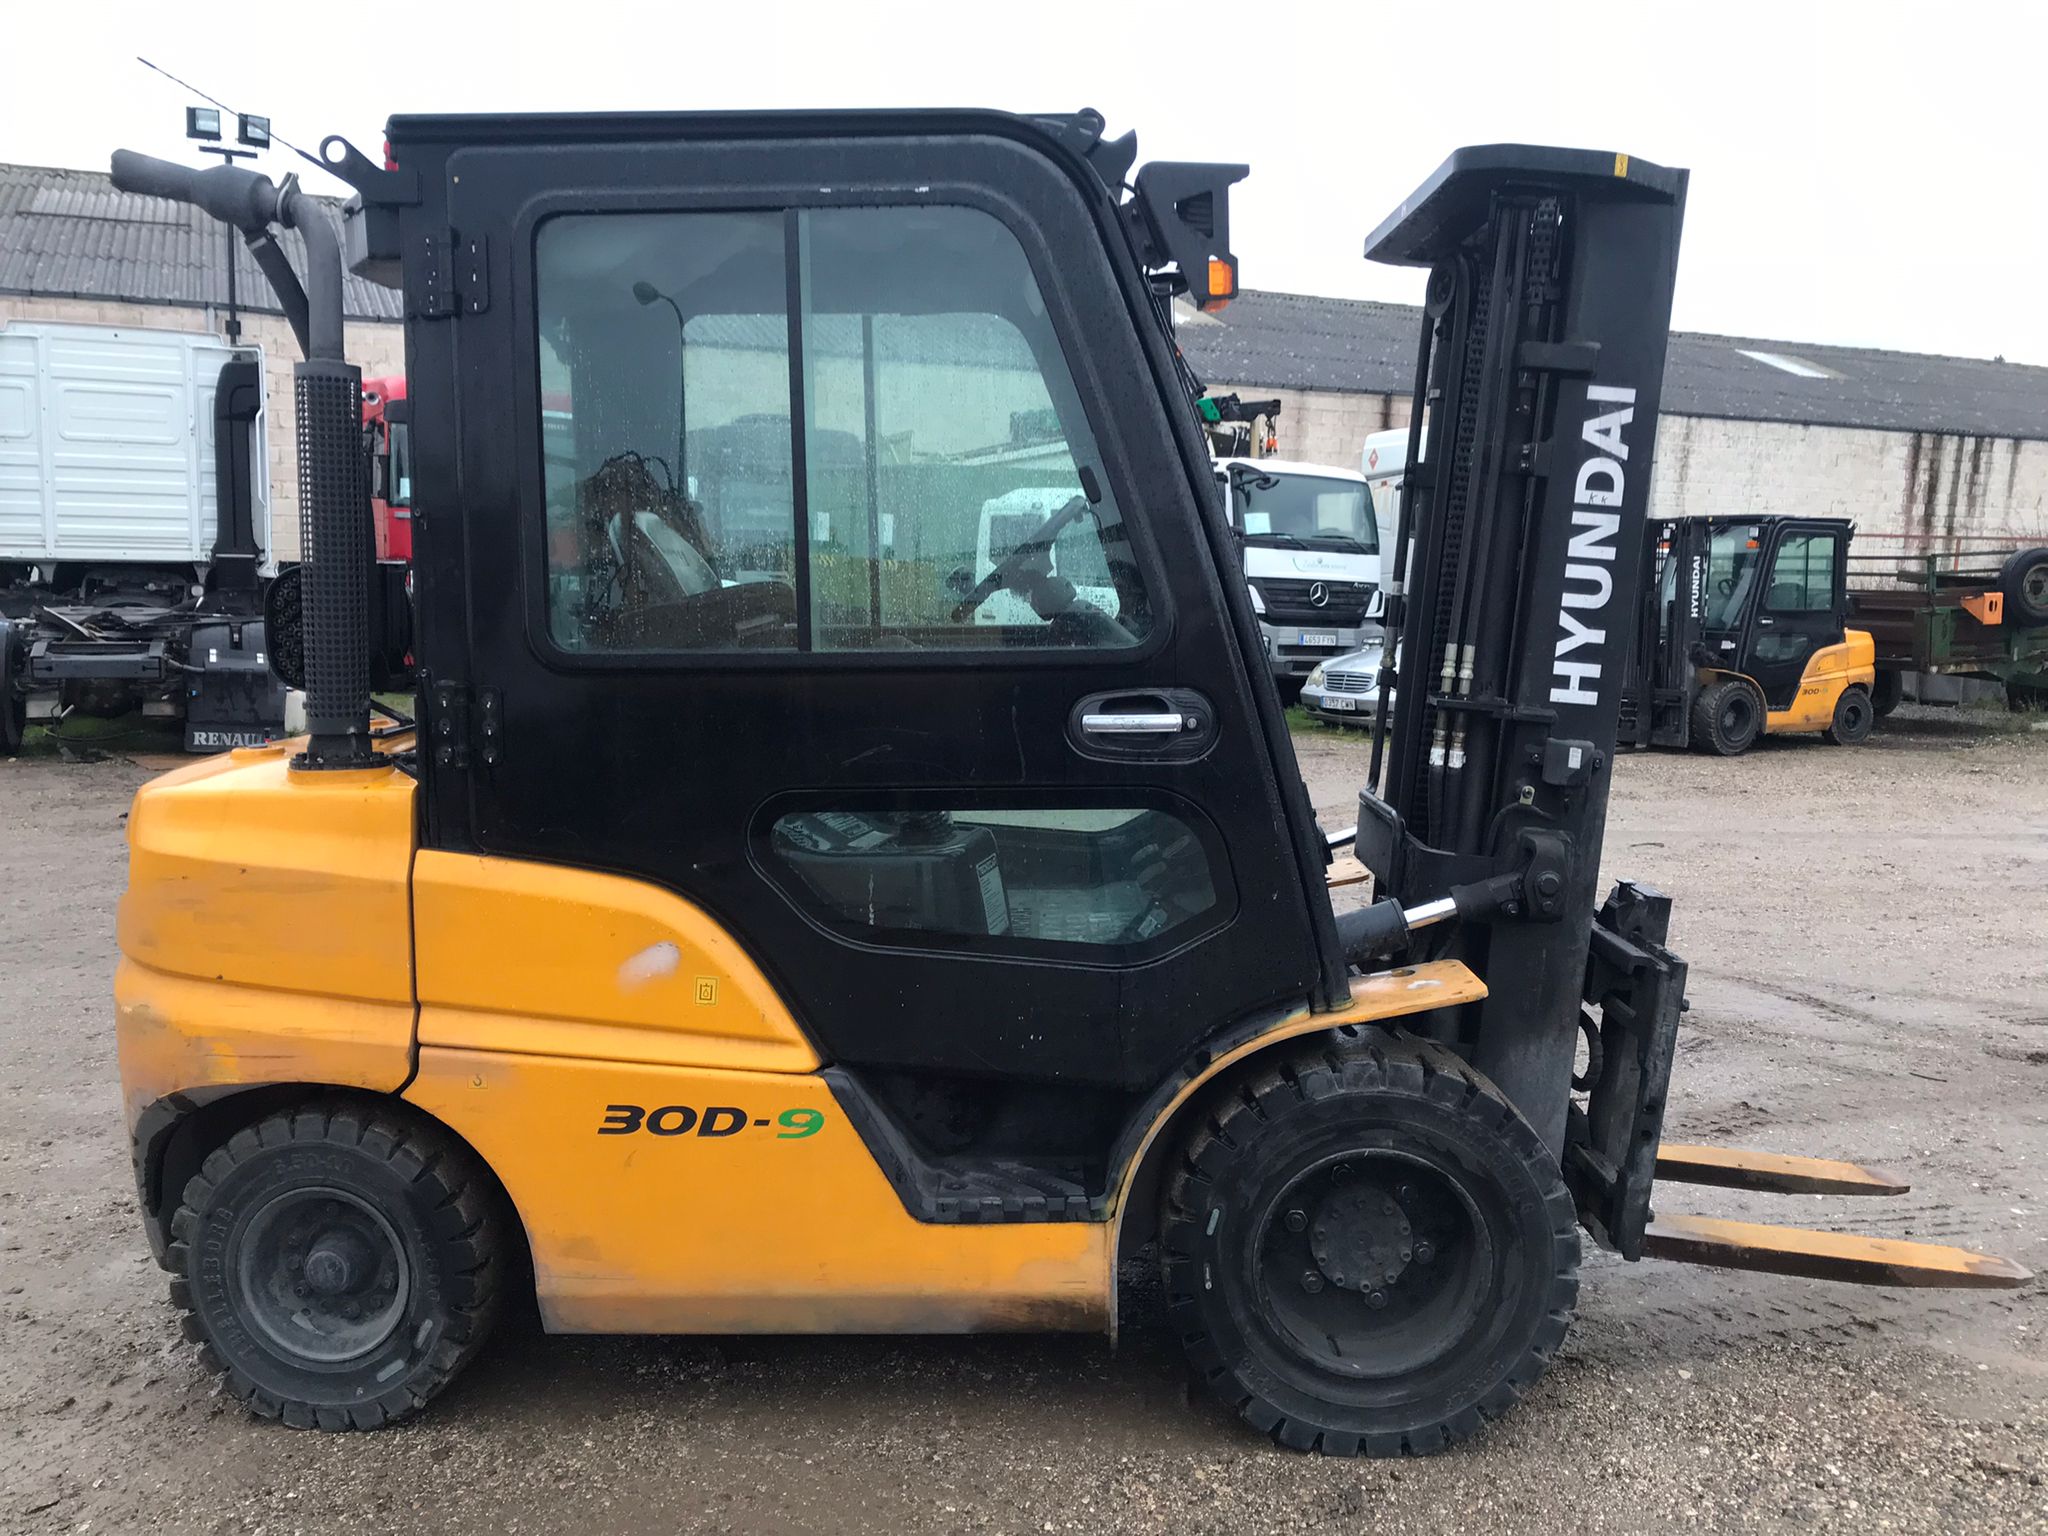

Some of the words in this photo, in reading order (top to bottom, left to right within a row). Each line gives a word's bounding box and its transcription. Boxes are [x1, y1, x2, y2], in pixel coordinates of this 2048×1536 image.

[1550, 384, 1637, 706] HYUNDAI
[1690, 555, 1701, 618] HYUNDAI
[597, 1105, 825, 1139] 30D-9
